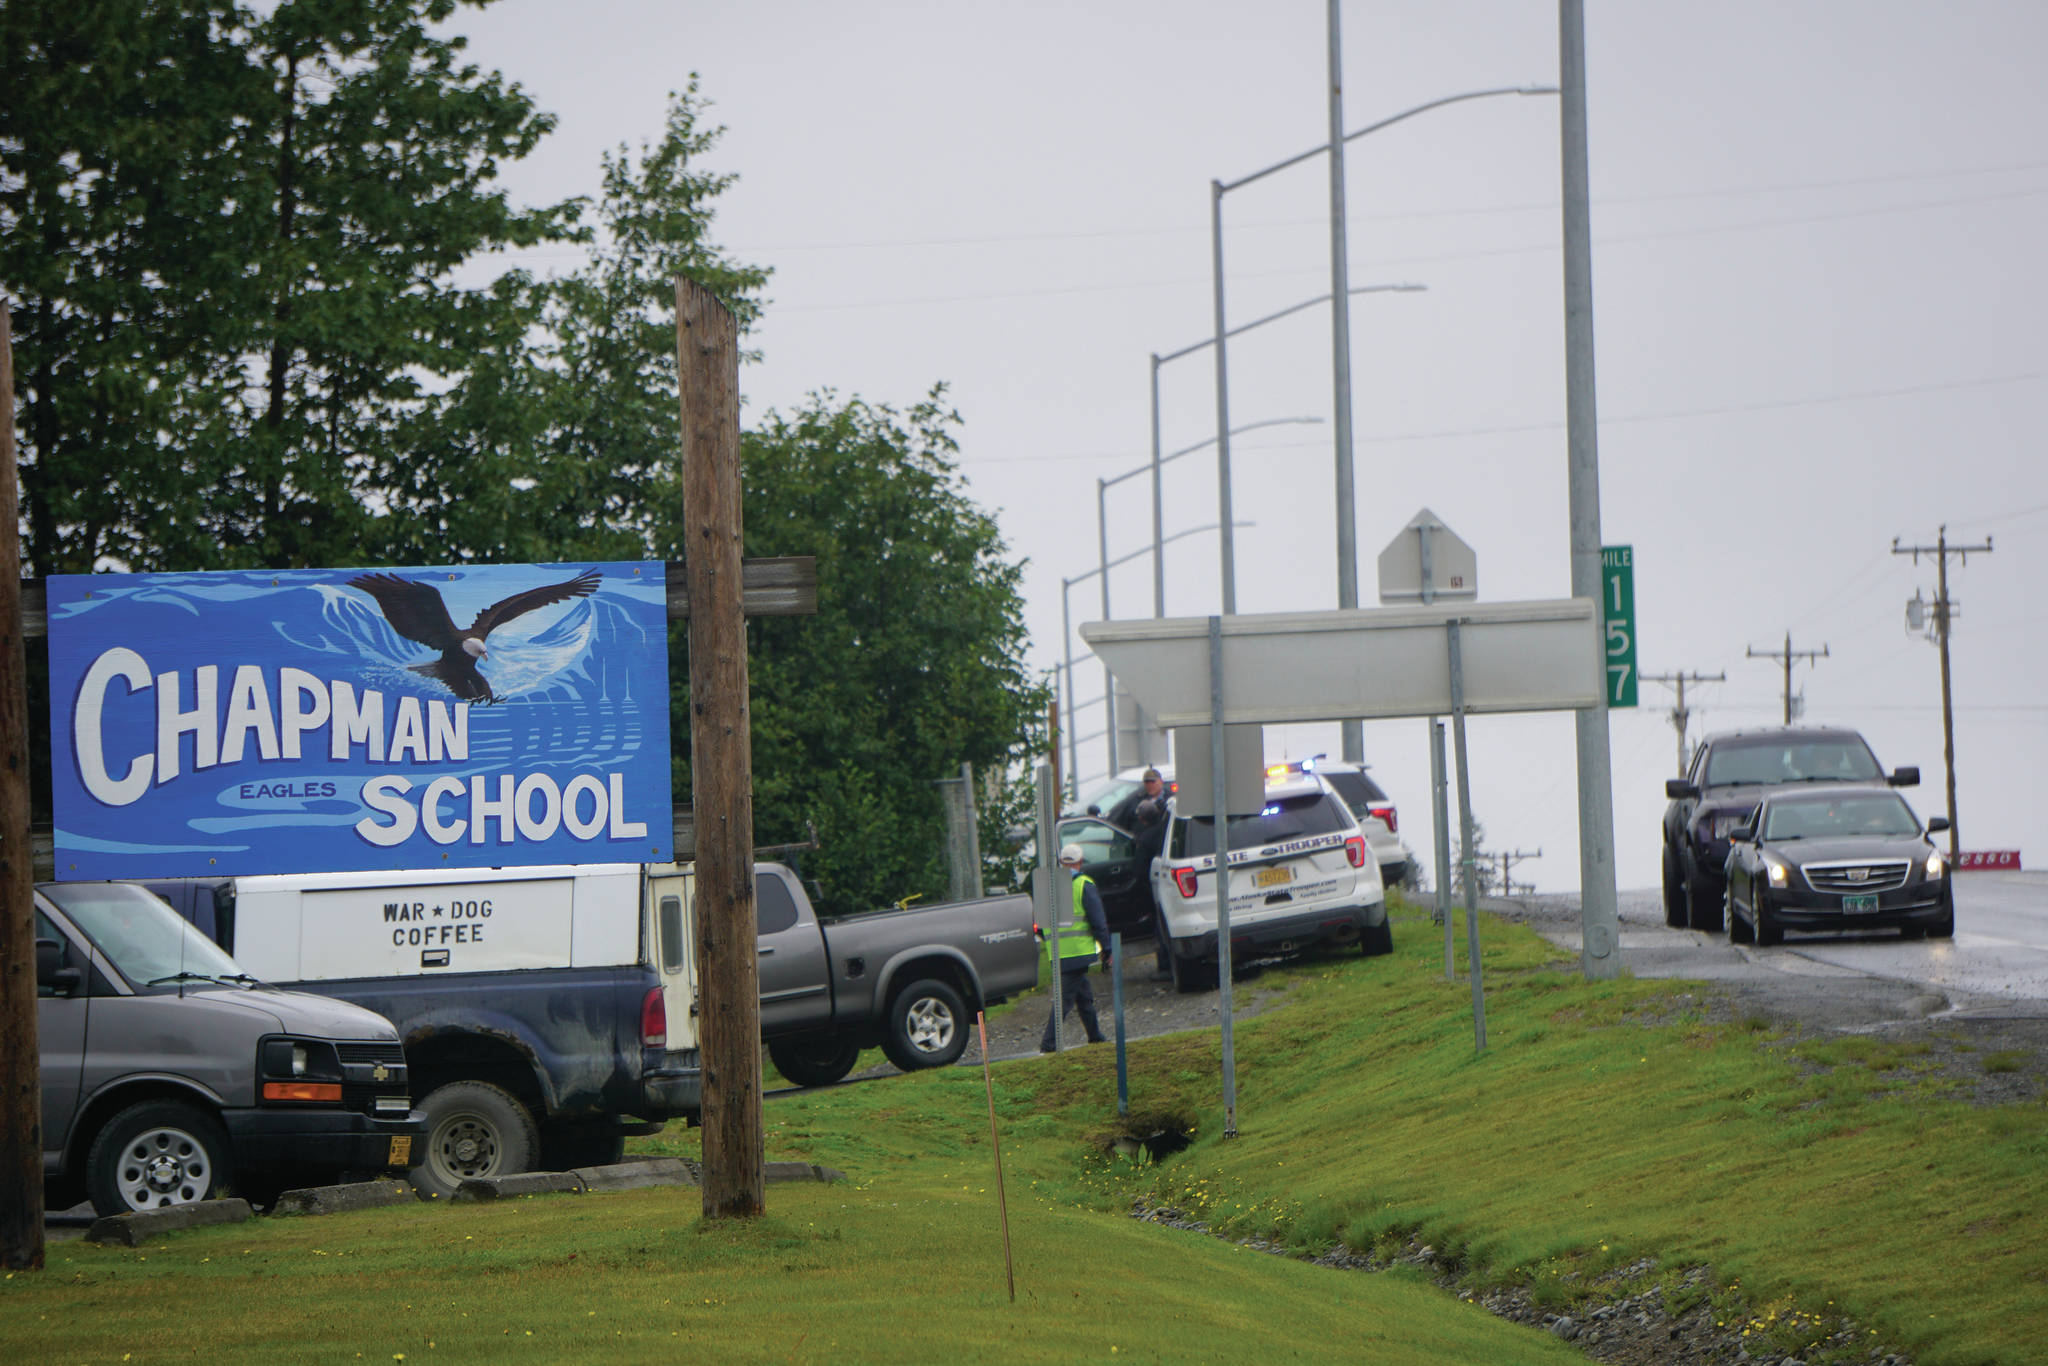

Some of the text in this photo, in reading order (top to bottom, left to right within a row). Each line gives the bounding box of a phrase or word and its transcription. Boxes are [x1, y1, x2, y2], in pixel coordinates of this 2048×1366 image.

[74, 646, 470, 808] CHAPMAN
[240, 781, 336, 799] EAGLES
[355, 773, 648, 847] SCHOOL
[1203, 834, 1343, 867] SATE TROOPER
[384, 900, 493, 922] WAR DOG
[393, 923, 484, 946] COFFEE
